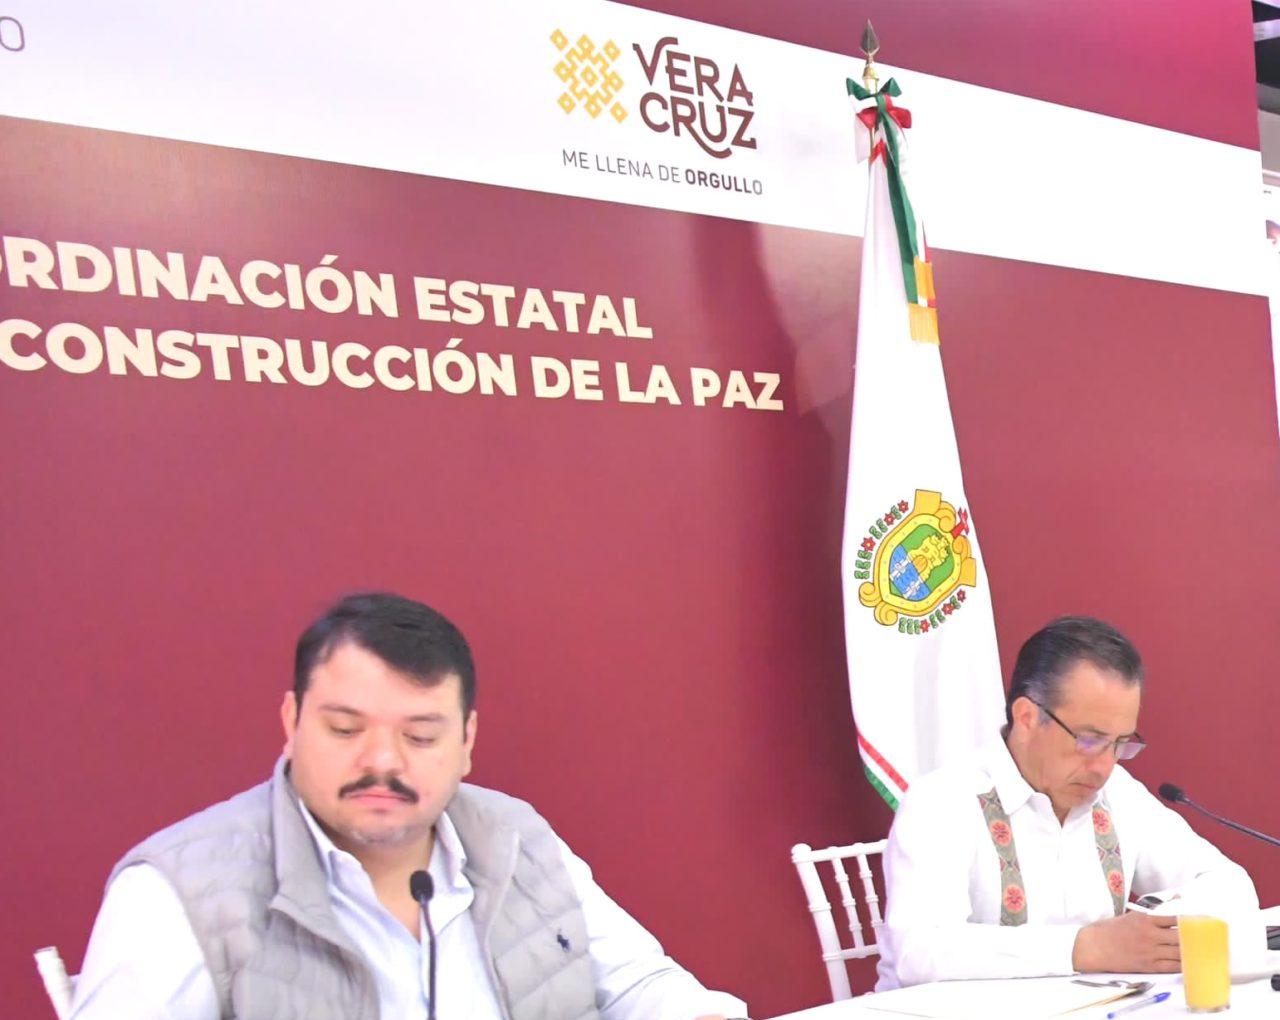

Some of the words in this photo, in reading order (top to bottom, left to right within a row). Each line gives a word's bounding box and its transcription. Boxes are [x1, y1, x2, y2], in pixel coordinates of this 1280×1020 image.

[632, 36, 754, 107] VERA
[639, 91, 757, 159] CRUZ
[562, 148, 590, 170] ME
[595, 153, 654, 180] LLENA
[658, 164, 681, 184] DE
[685, 168, 763, 196] ORGULLO
[0, 235, 399, 319] RDINACIÓN
[413, 276, 654, 339] ESTATAL
[0, 318, 518, 397] CONSTRUCCIÓN
[530, 355, 604, 401] DE
[615, 361, 682, 405] LA
[690, 366, 785, 411] PAZ
